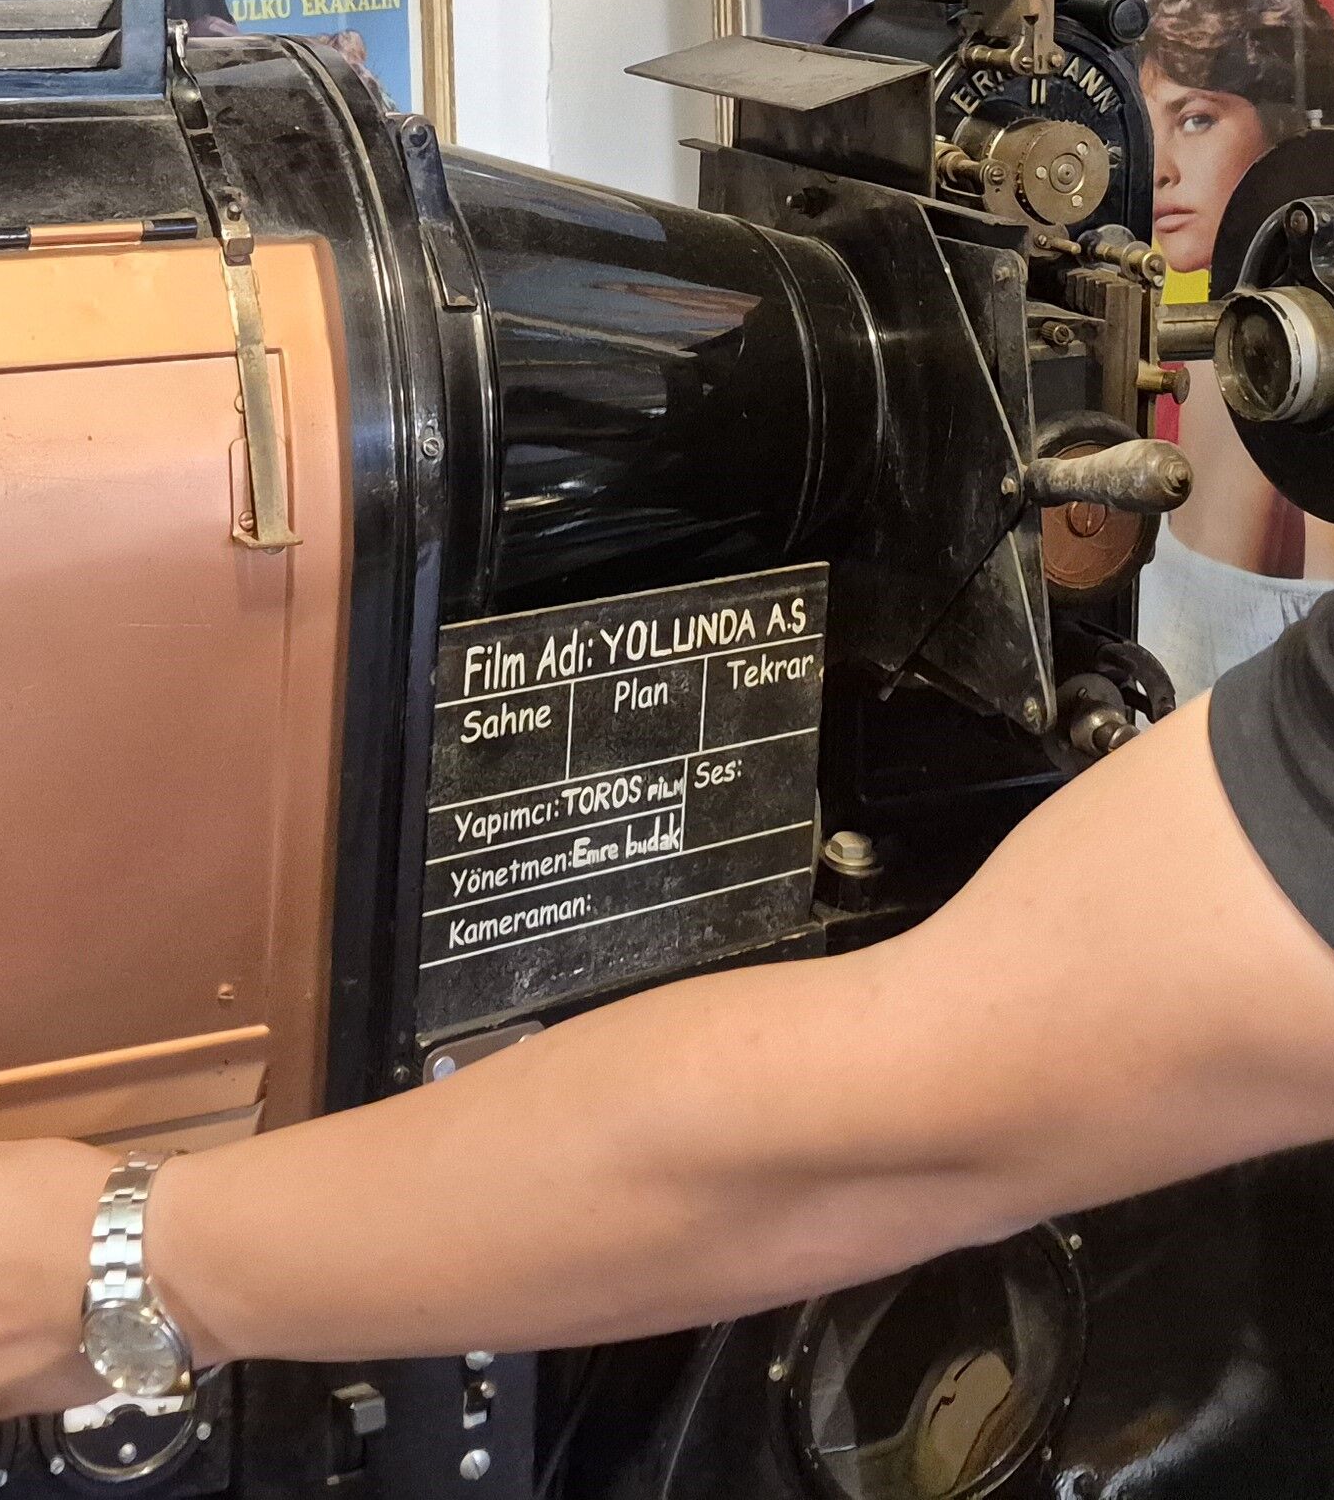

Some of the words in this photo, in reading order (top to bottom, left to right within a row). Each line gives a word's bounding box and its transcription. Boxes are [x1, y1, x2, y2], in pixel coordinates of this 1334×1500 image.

[463, 641, 526, 697] Film
[460, 702, 552, 744] Sahne
[614, 678, 668, 714] Plan
[727, 654, 814, 690] Tekrar
[561, 775, 643, 816] TOROS
[694, 760, 742, 789] Ses:
[573, 837, 618, 868] Emre
[449, 894, 592, 949] Kameraman:
